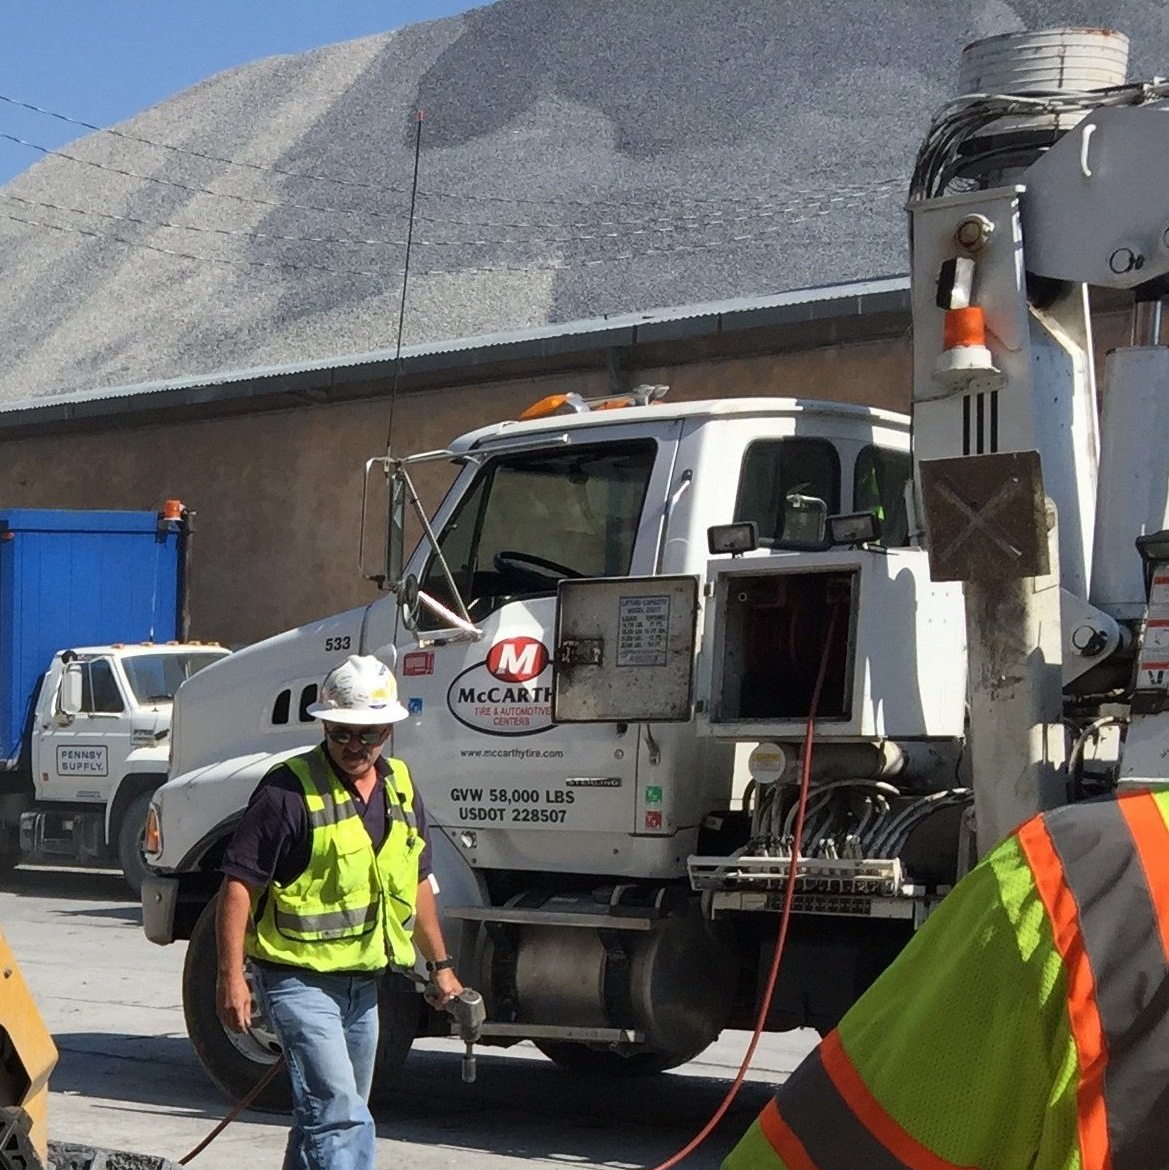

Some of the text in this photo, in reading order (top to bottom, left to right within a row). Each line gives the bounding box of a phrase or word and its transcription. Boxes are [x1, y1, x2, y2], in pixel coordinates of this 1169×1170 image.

[325, 636, 351, 652] 533
[495, 643, 539, 675] M
[458, 687, 553, 703] McCARTH
[474, 706, 552, 716] TIRE & AUTOMOTIVE
[493, 717, 530, 726] CENTERS
[460, 748, 564, 760] www.mccarthytire.com
[450, 788, 575, 805] GVW 58,000 LBS
[459, 807, 567, 823] USDOT 228507
